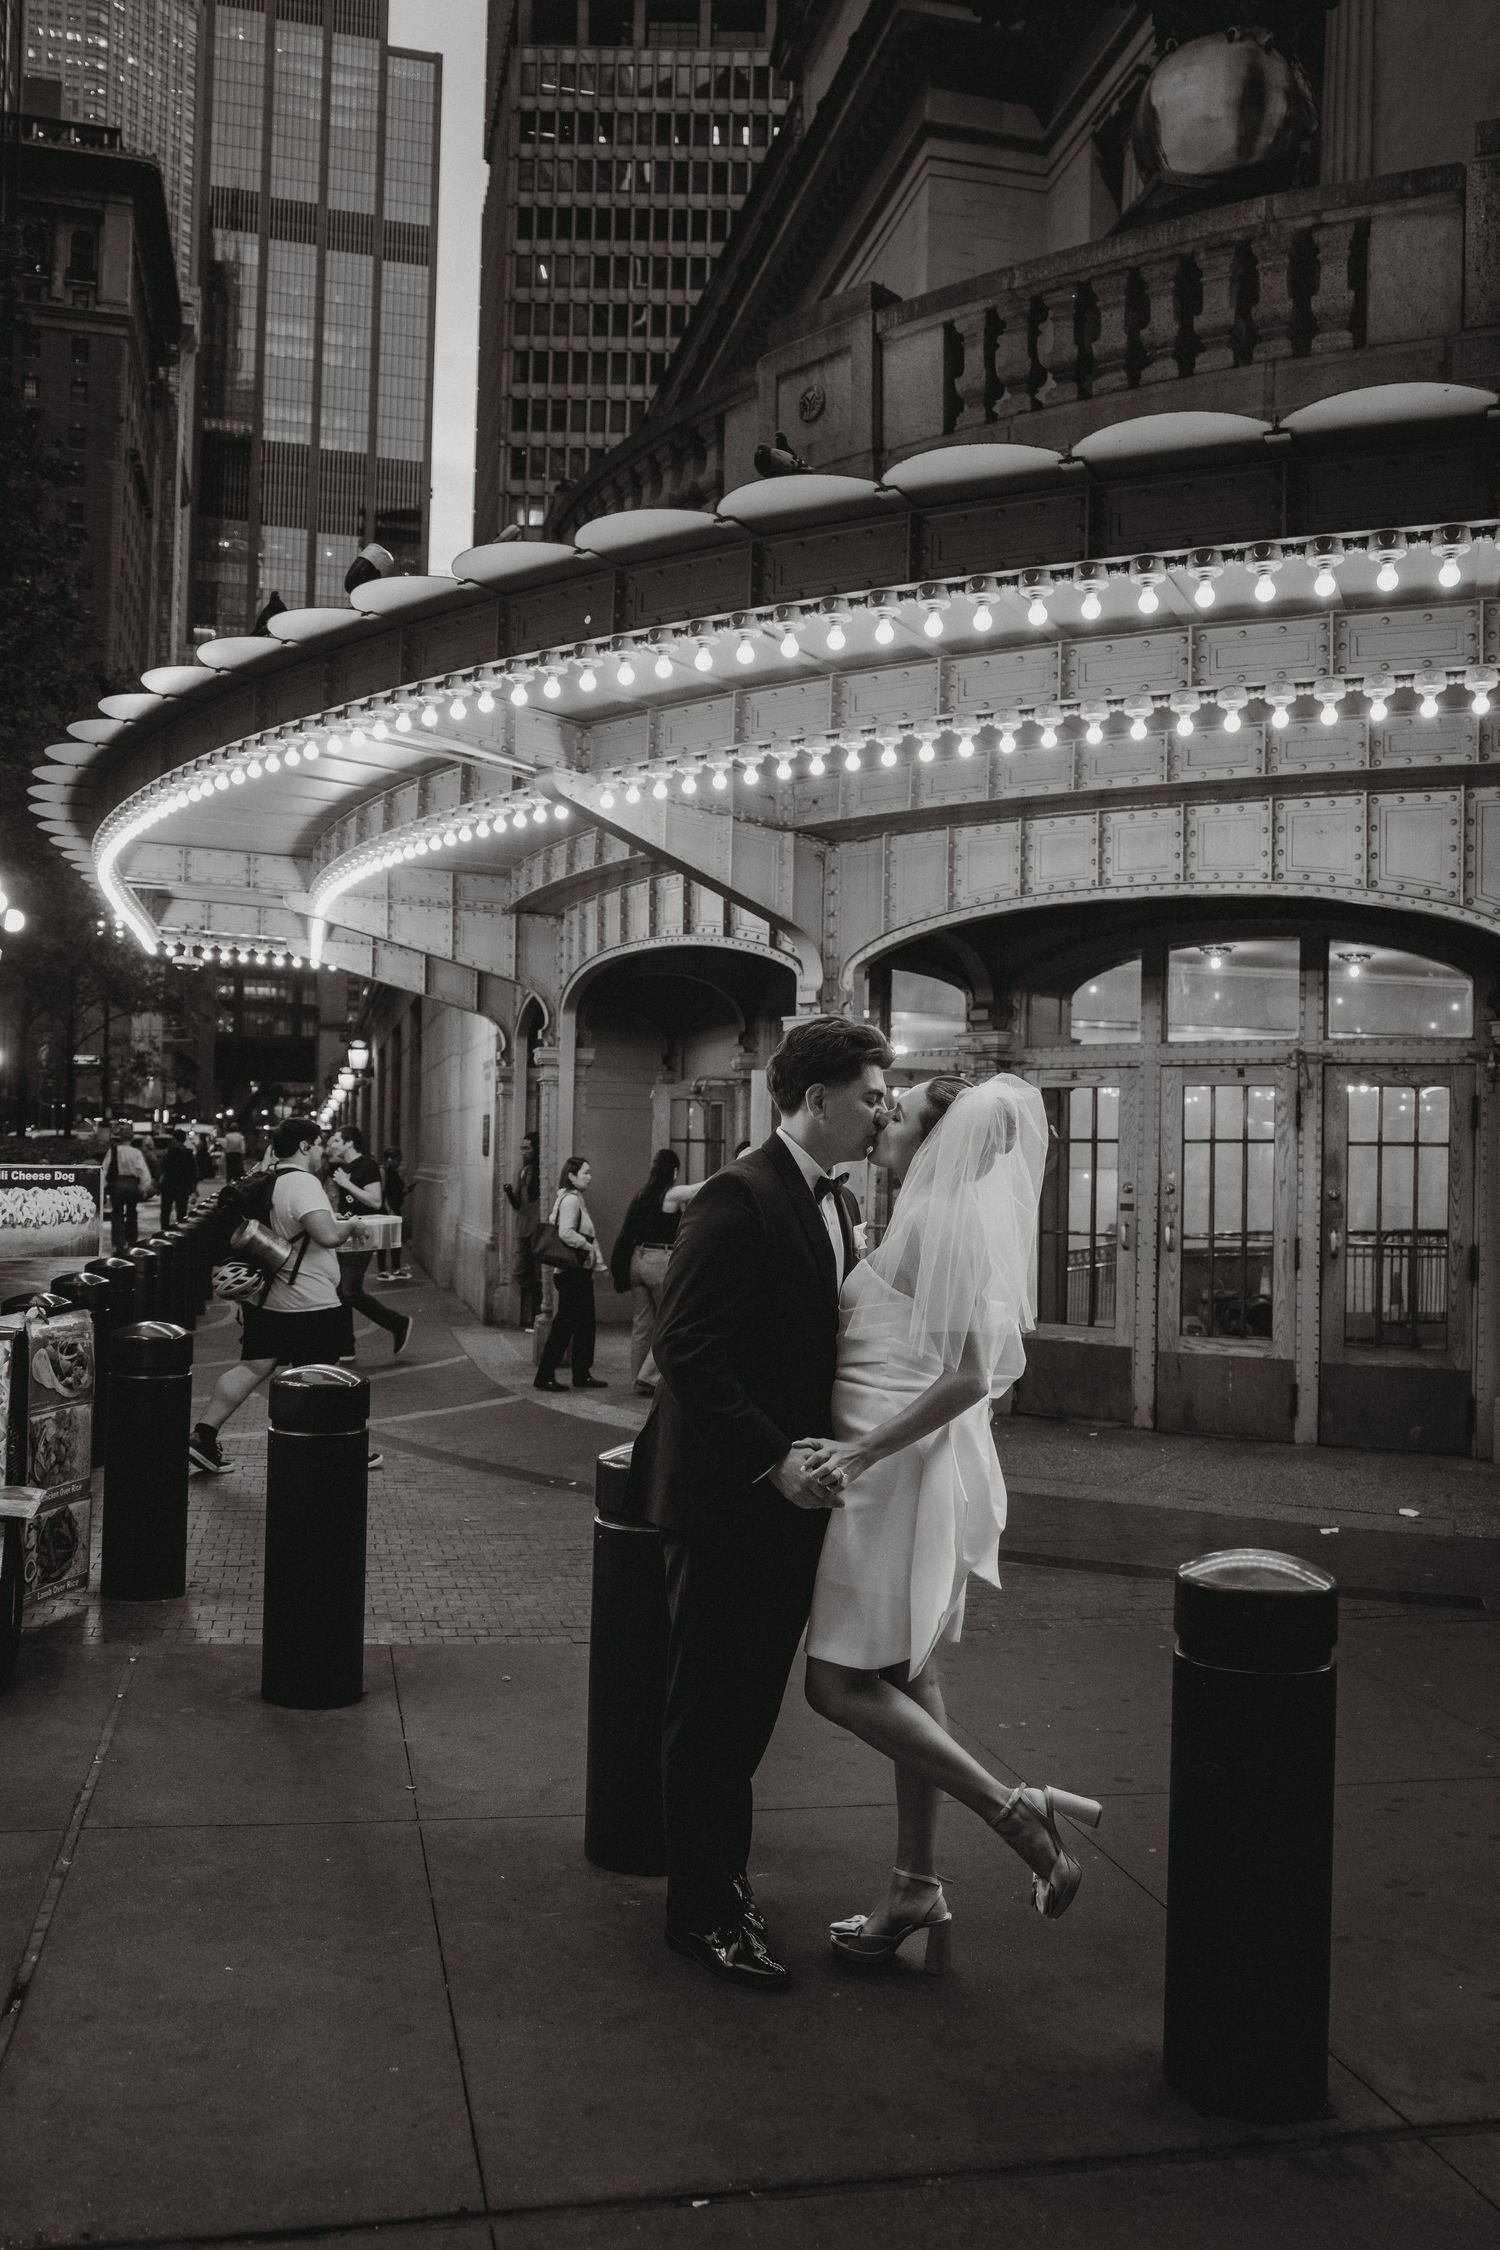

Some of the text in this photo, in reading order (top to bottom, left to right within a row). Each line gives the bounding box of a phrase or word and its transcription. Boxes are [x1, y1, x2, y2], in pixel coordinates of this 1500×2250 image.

[11, 1170, 51, 1180] Cheese
[54, 1170, 75, 1182] Dog
[60, 1487, 71, 1496] Over
[71, 1483, 82, 1492] Rice
[37, 1588, 52, 1600] Lamb
[52, 1584, 66, 1594] Over
[66, 1579, 80, 1589] Rice
